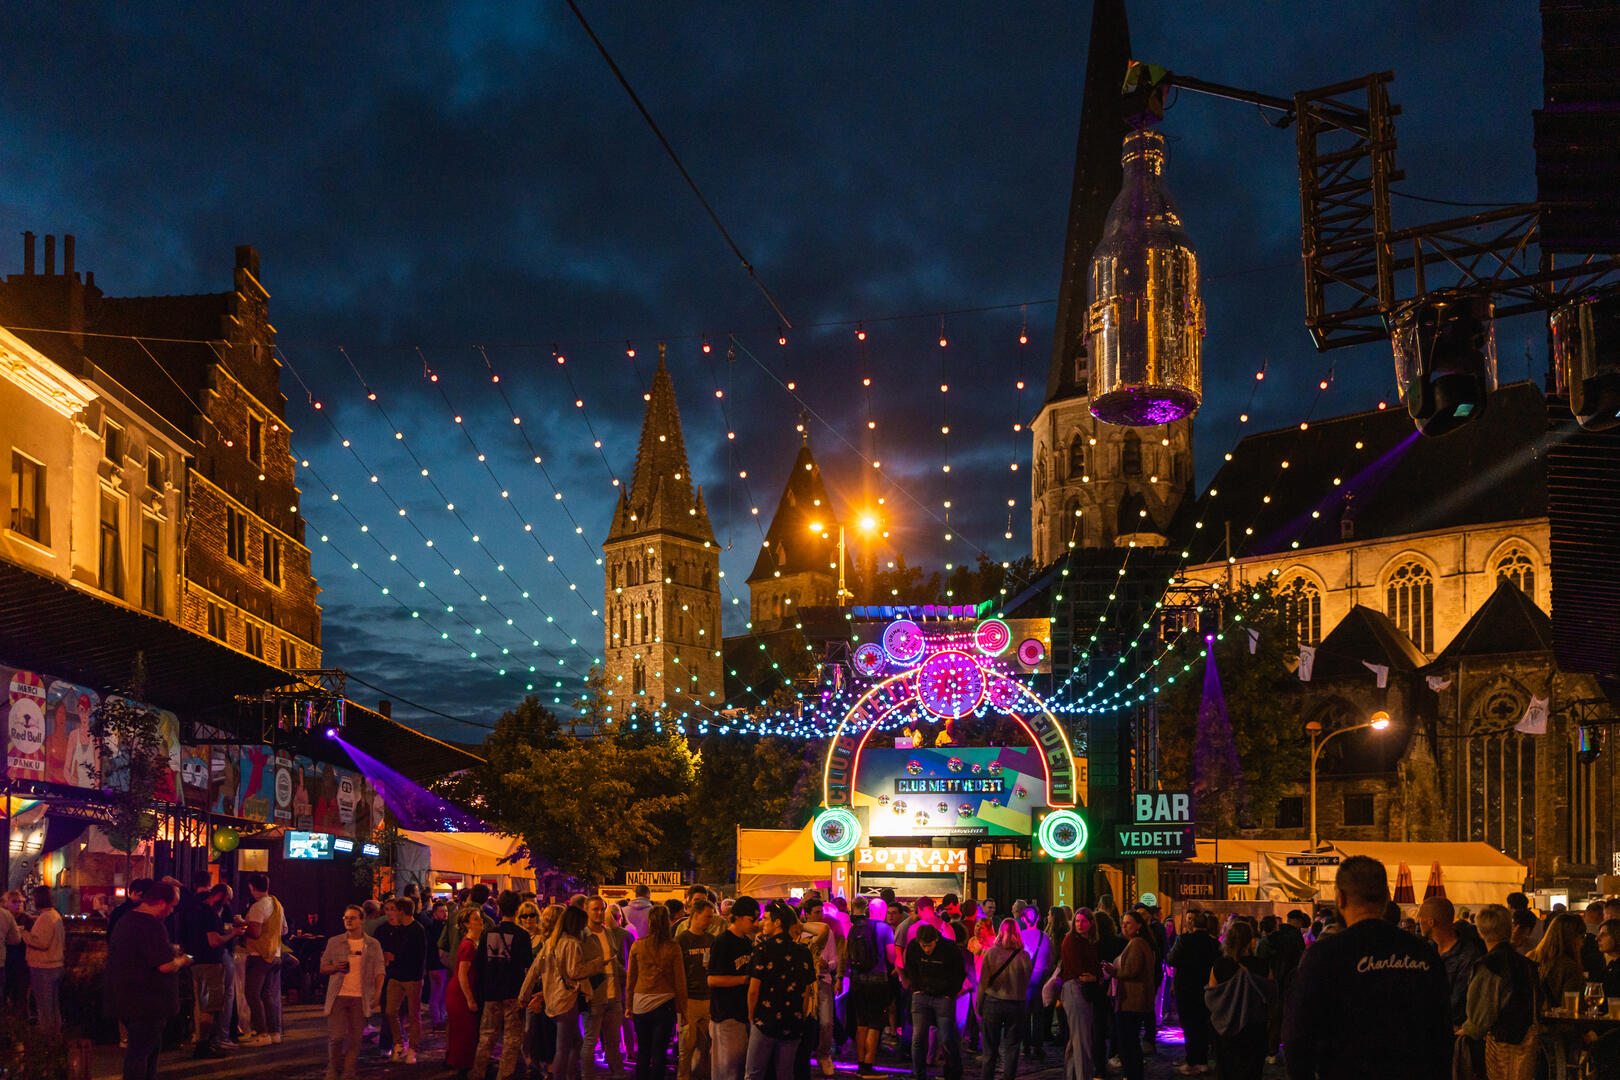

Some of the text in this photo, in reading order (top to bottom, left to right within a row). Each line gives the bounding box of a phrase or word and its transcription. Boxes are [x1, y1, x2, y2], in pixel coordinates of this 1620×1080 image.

[971, 669, 980, 693] EXTRA
[17, 684, 38, 695] MERCI
[11, 728, 42, 743] Red Bull
[13, 759, 40, 770] DANK U
[828, 736, 855, 804] CLUB
[1029, 712, 1073, 799] EDETT
[899, 780, 1002, 792] CLUB METT VEDETT
[1136, 794, 1189, 821] BAR
[1120, 832, 1183, 846] VEDETT
[858, 849, 966, 867] BOTRAM
[1356, 953, 1430, 973] Charlatan
